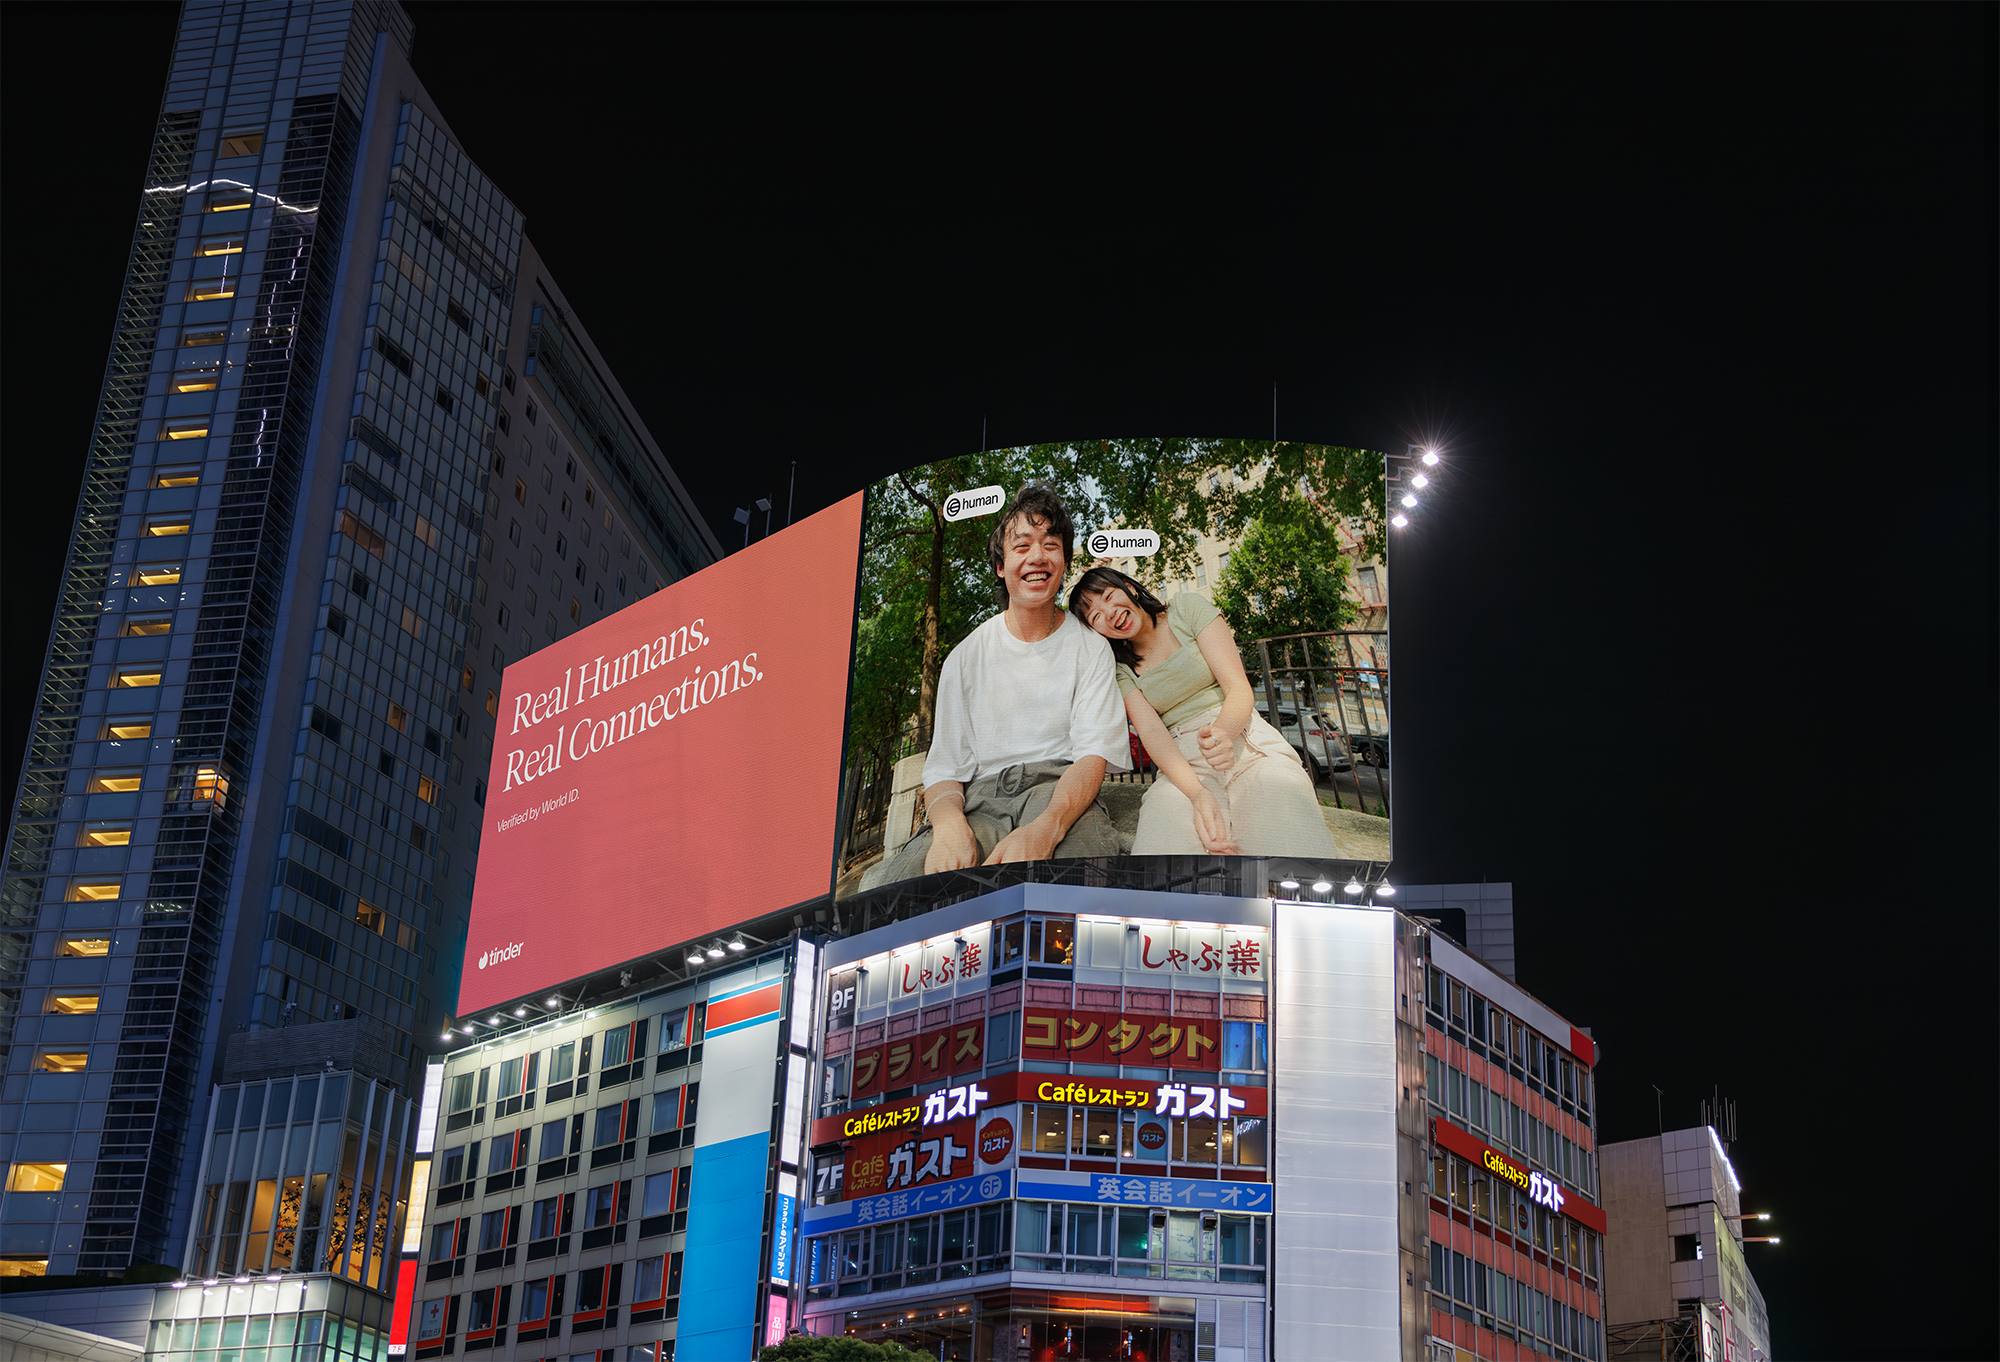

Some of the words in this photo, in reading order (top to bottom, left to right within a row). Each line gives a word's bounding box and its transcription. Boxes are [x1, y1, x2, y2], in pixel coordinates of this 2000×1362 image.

[962, 493, 999, 511] human
[1110, 536, 1153, 550] human
[510, 667, 572, 736] Real
[574, 618, 710, 706] Humans.
[502, 724, 565, 793] Real
[568, 652, 764, 761] Connections.
[497, 808, 529, 833] Verified
[529, 807, 541, 821] by
[541, 792, 568, 814] World
[568, 788, 580, 803] ID.
[489, 941, 524, 967] tinder
[902, 942, 982, 994] しゃぶ葉
[1142, 934, 1261, 976] しゃぶ葉
[831, 986, 855, 1012] 9F
[1025, 1015, 1216, 1059] コンタクト
[855, 1026, 982, 1089] プライス
[923, 1083, 989, 1126] ガスト
[1155, 1082, 1246, 1120] ガスト
[982, 1136, 1011, 1154] ガスト
[1141, 1133, 1164, 1143] ガスト
[816, 1163, 844, 1192] 7F
[852, 1153, 884, 1178] Café
[886, 1135, 968, 1190] ガスト
[851, 1175, 883, 1192] レストラン
[857, 1183, 974, 1223] 英会話イーオン
[981, 1178, 1000, 1196] 6F
[1097, 1176, 1267, 1208] 英会話イーオン
[1529, 1170, 1565, 1213] ガスト
[392, 1345, 403, 1353] 7F
